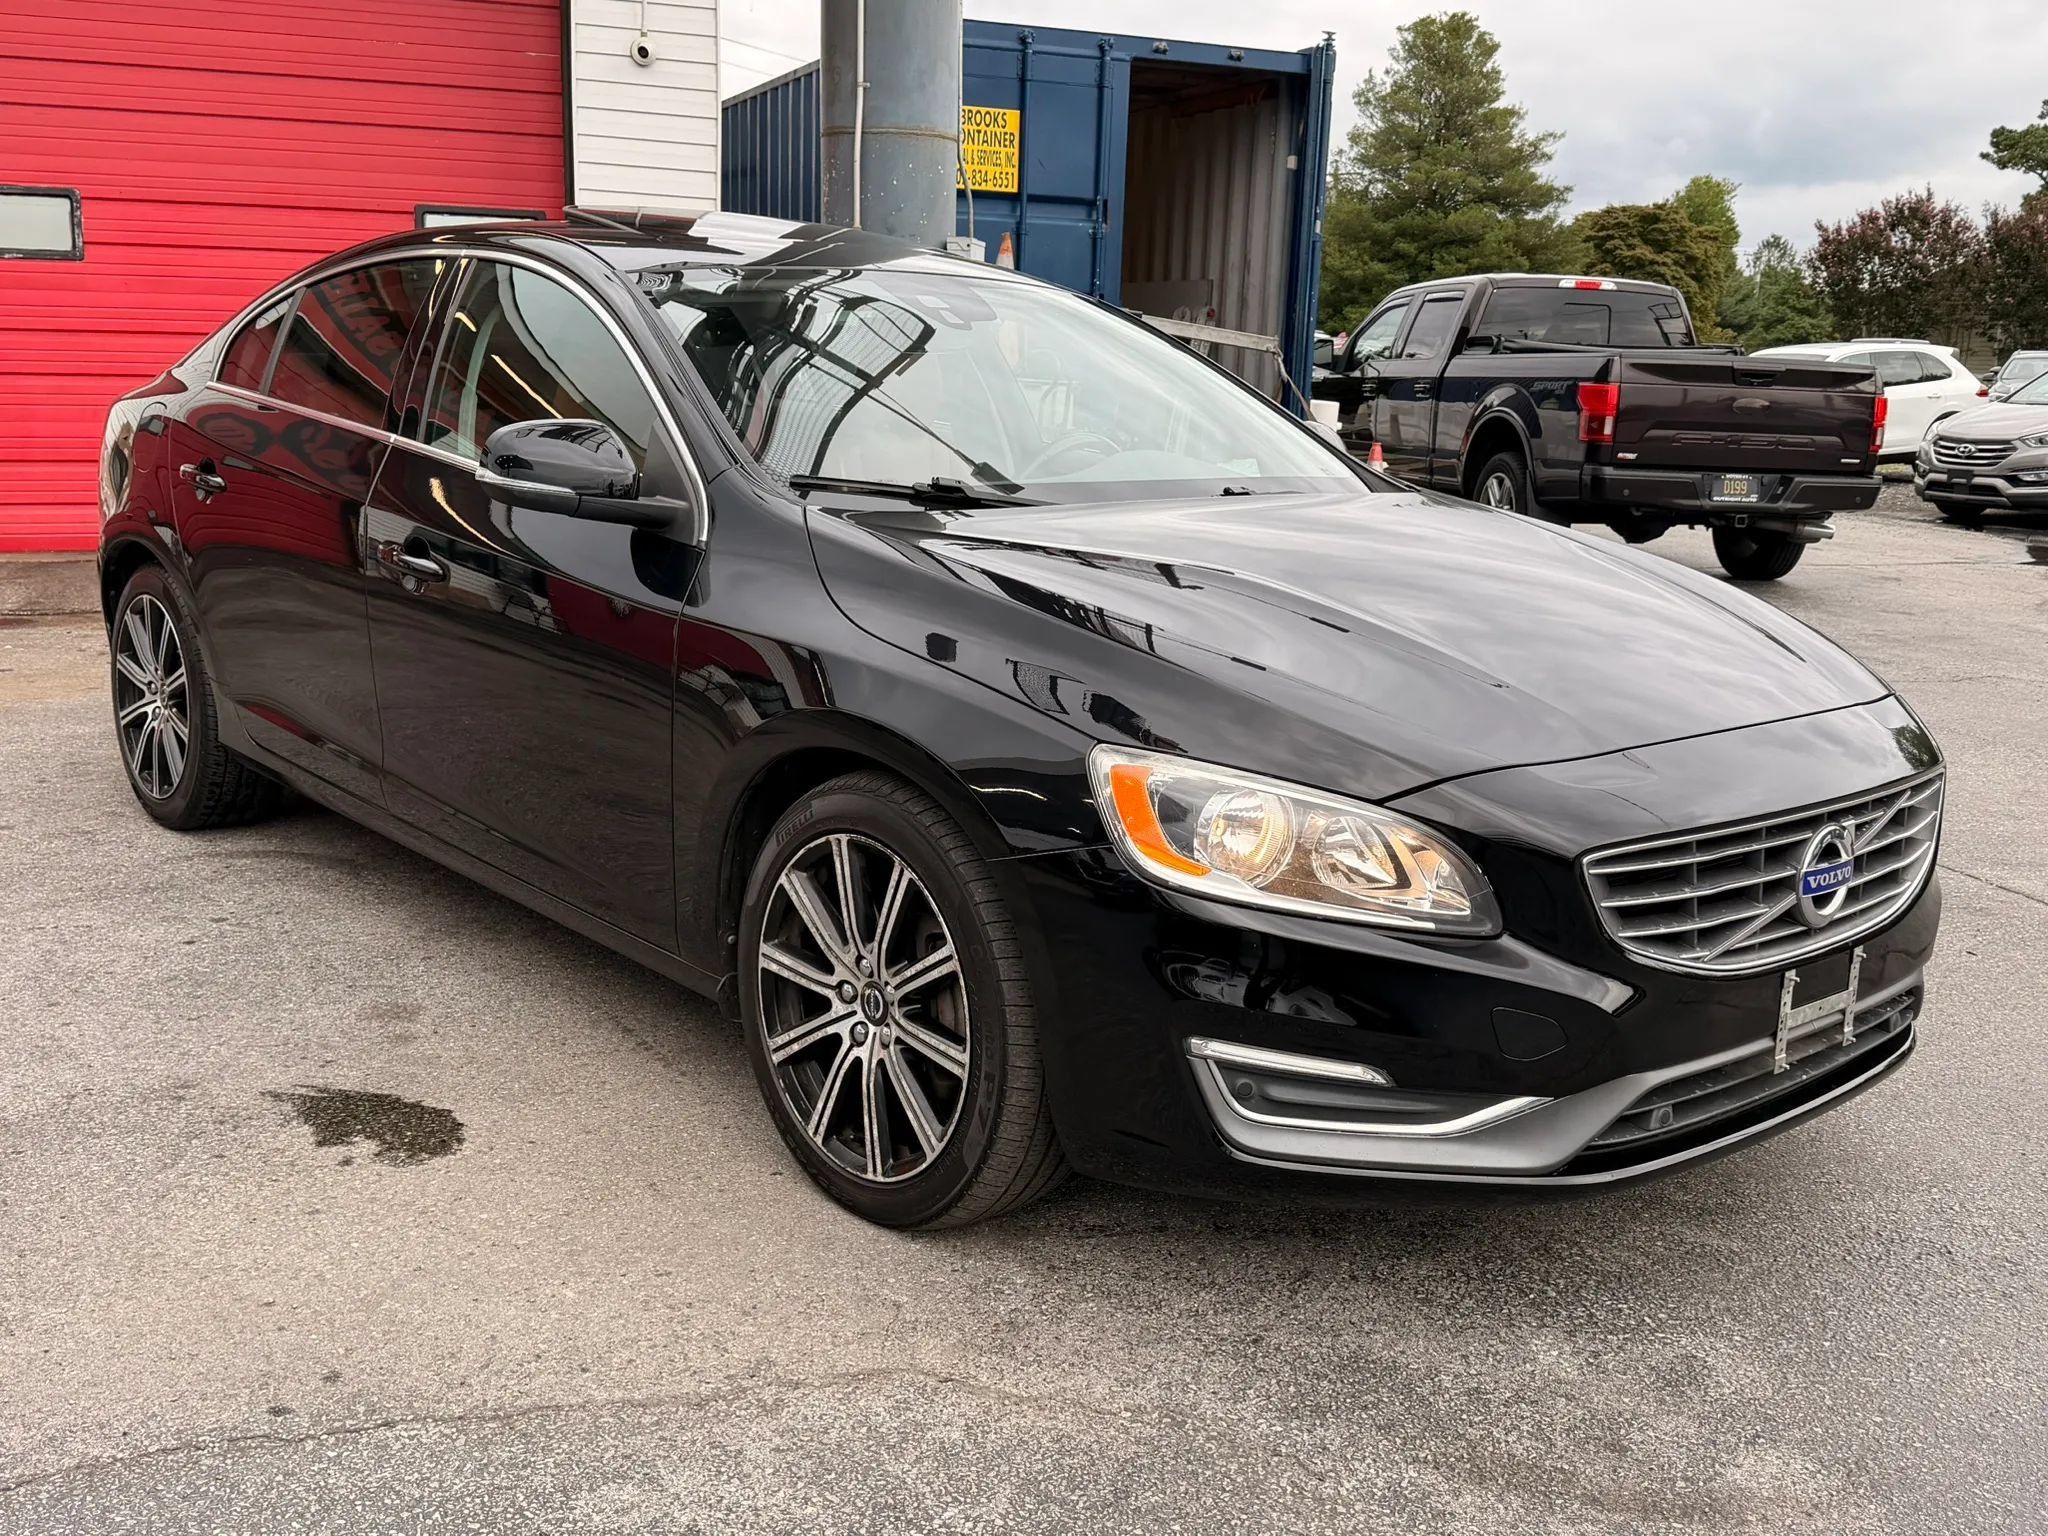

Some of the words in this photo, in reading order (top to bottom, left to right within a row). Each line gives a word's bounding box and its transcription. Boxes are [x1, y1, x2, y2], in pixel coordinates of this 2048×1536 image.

[1530, 380, 1573, 393] SPORT
[774, 803, 813, 847] PIRELLI
[1807, 866, 1851, 889] VOLVO
